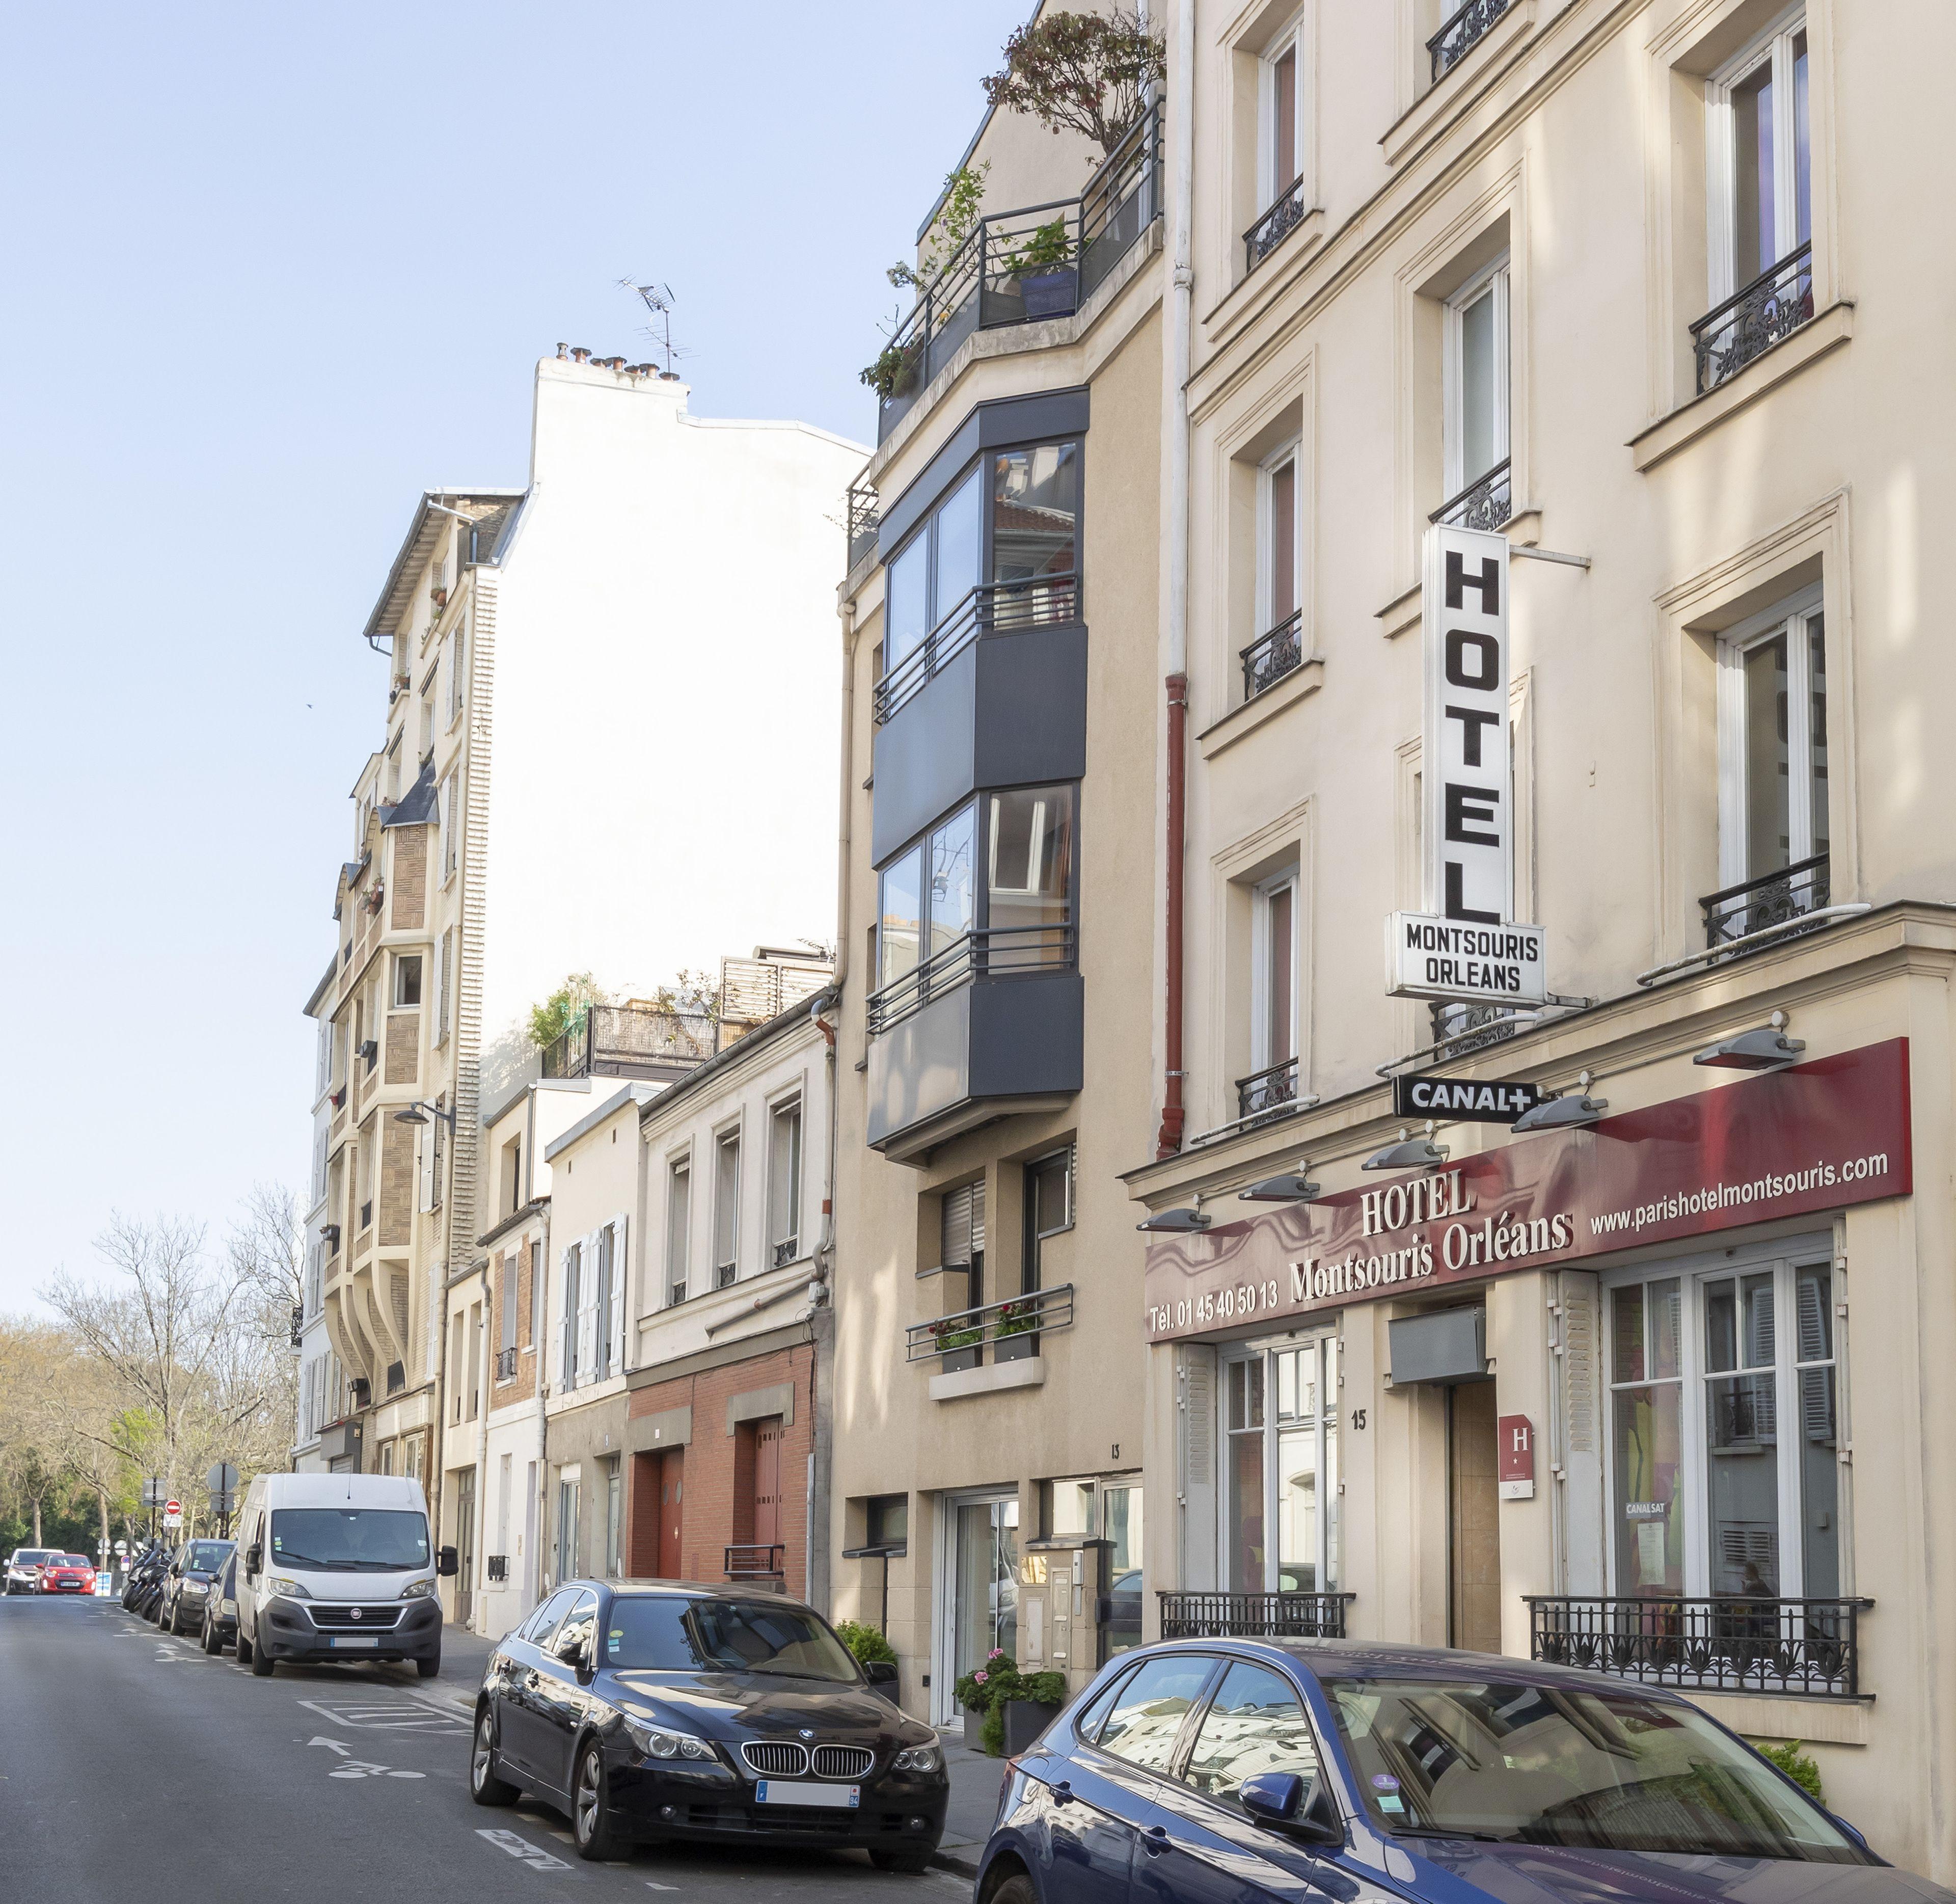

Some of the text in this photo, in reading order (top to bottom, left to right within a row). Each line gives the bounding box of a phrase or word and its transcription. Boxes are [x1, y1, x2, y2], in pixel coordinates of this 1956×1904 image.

[1446, 550, 1500, 926] HOTEL
[1407, 923, 1538, 962] MONTSOURIS
[1426, 957, 1520, 992] ORLEANS
[1411, 1082, 1531, 1112] CANAL+
[1360, 1168, 1472, 1238] HOTEL
[1590, 1152, 1889, 1235] www.parishotelmontsouris.com
[1289, 1211, 1568, 1303] Montsouris Orléans
[1150, 1279, 1279, 1332] Tél. 01 45 40 50 13
[1351, 1409, 1367, 1430] 15
[1111, 1444, 1120, 1460] 13
[1512, 1427, 1529, 1453] H
[850, 1796, 858, 1805] 94
